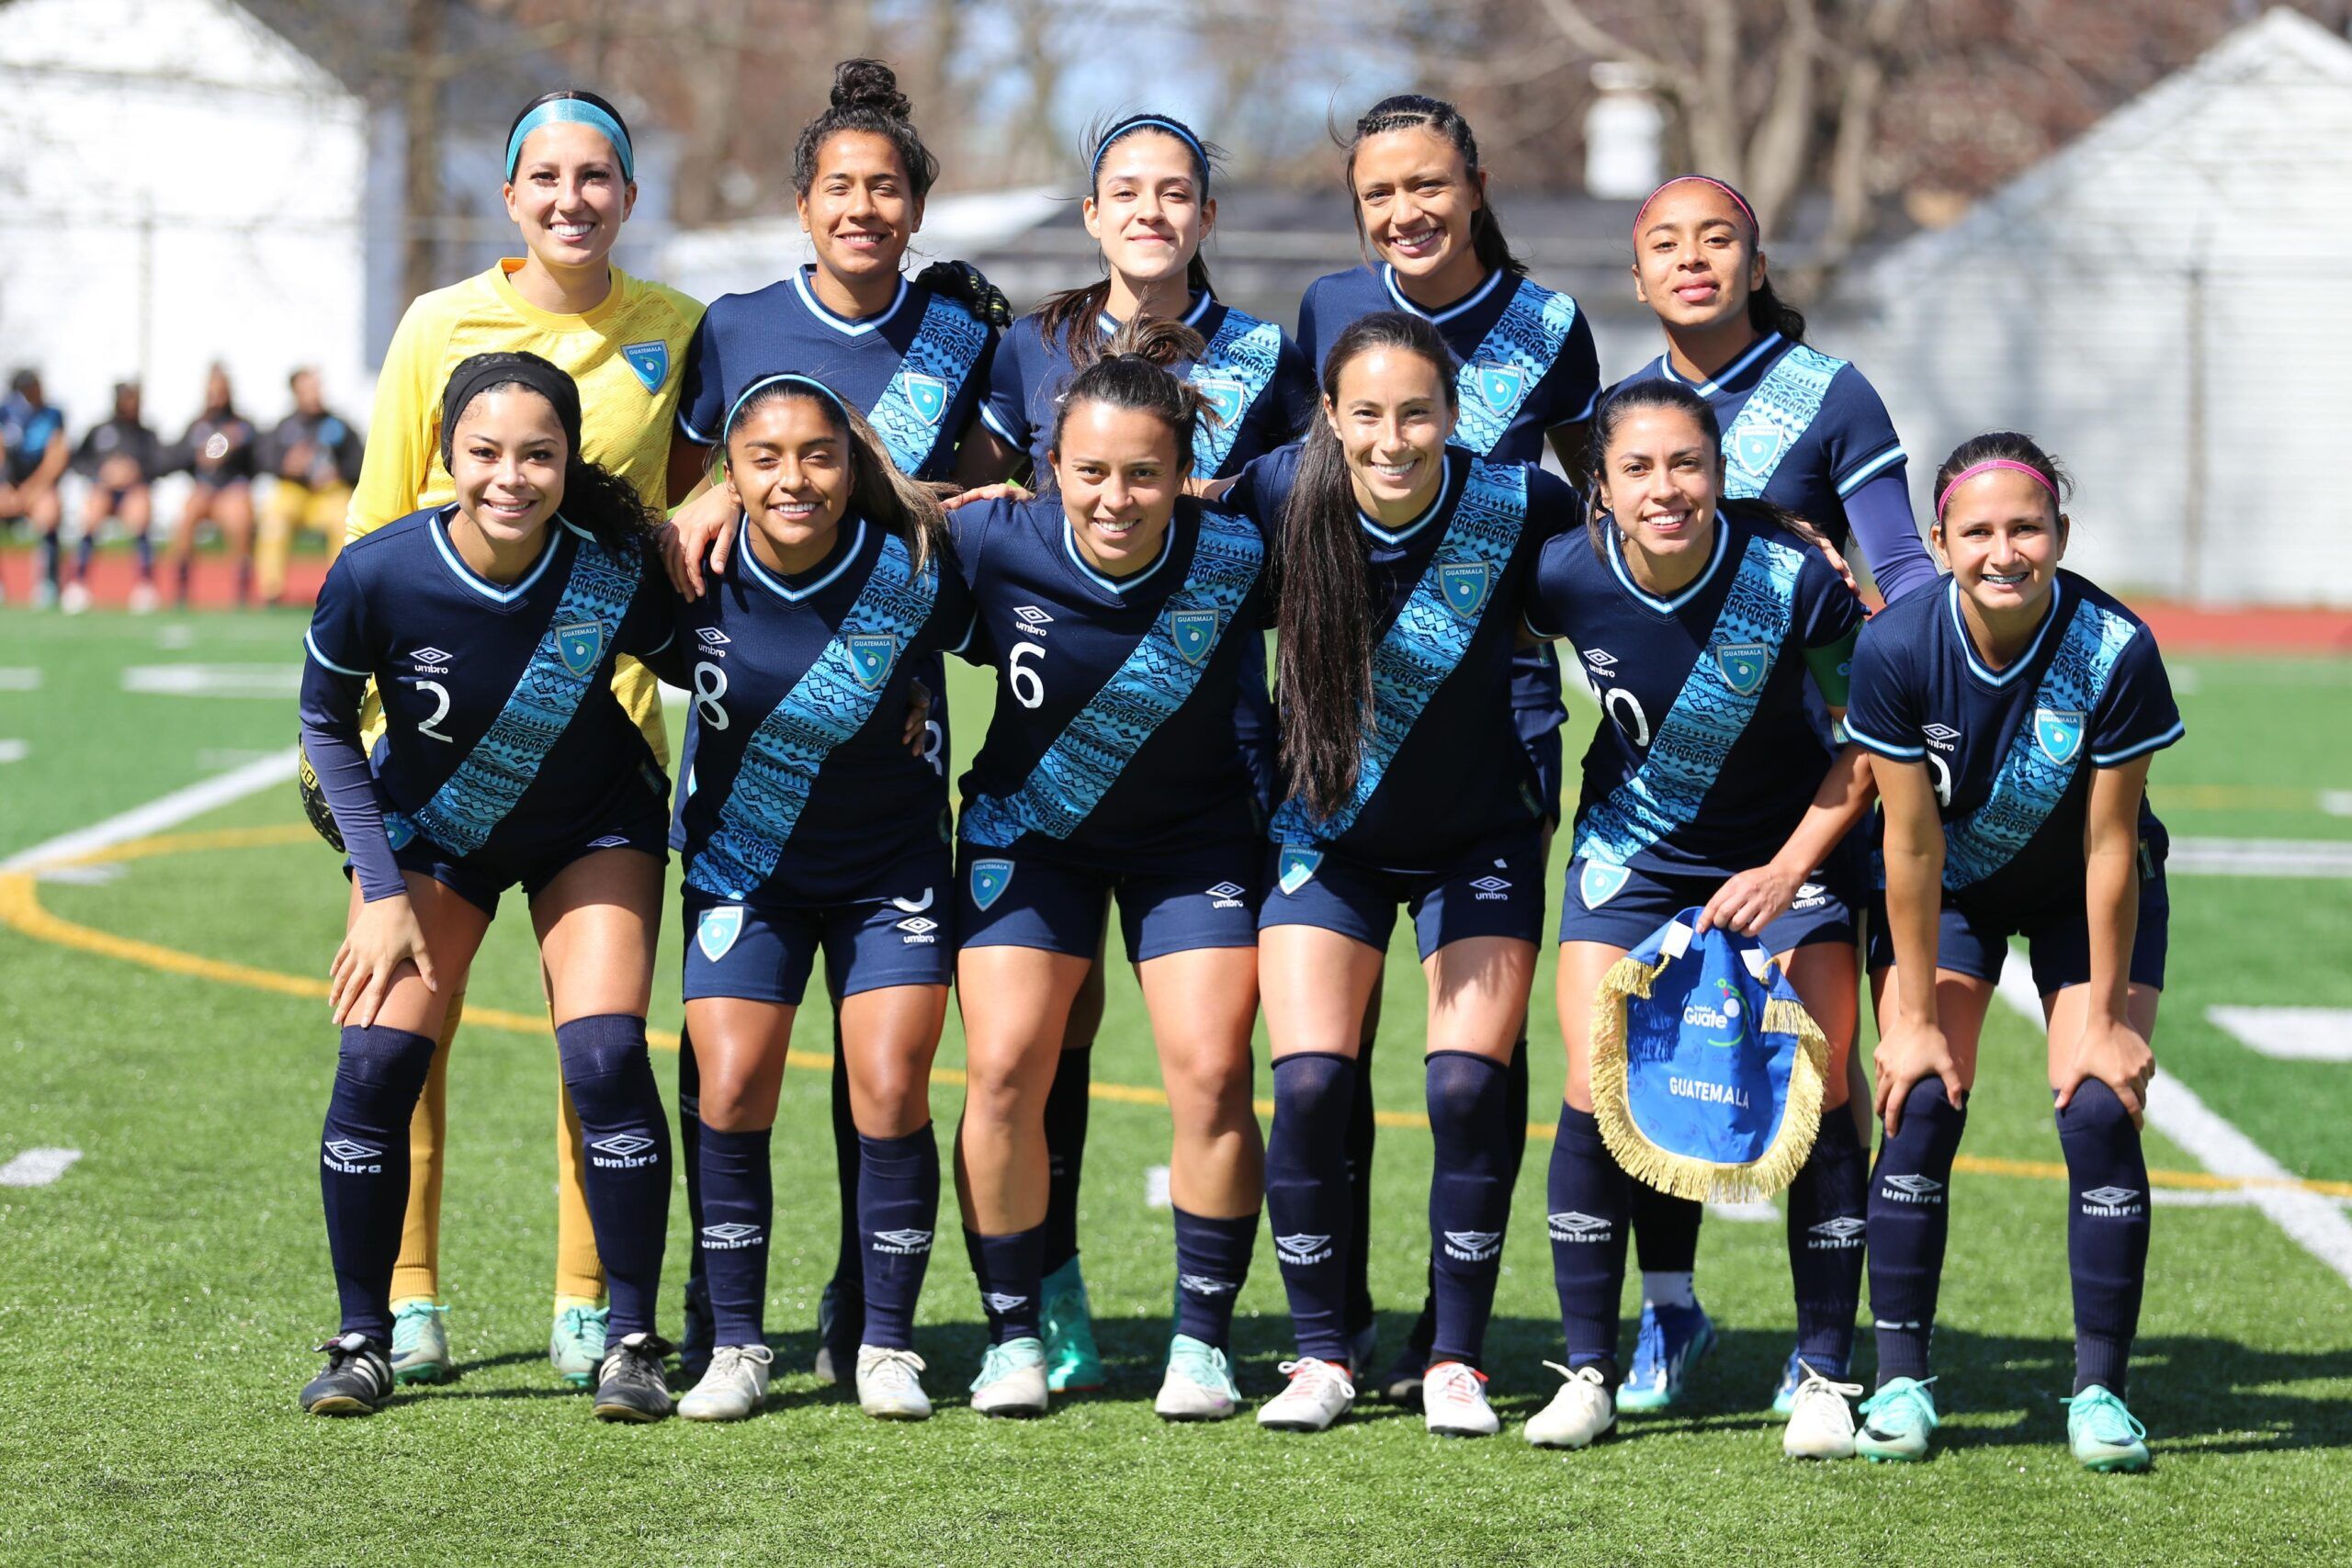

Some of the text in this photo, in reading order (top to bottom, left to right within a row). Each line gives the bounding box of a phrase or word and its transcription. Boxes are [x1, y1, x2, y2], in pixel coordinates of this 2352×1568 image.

[628, 346, 662, 355] GUATEMALA
[1445, 568, 1484, 577] GUATEMALA
[561, 627, 597, 637] GUATEMALA
[1015, 620, 1047, 637] umbro
[698, 643, 726, 658] umbro
[1724, 649, 1762, 658] GUATEMALA
[414, 664, 448, 674] umbro
[1010, 641, 1046, 708] 6
[695, 661, 729, 730] 8
[415, 681, 453, 743] 2
[2040, 716, 2078, 724] GUATEMALA
[1927, 738, 1955, 752] mbro
[975, 863, 1009, 872] GUATEMALA
[1213, 897, 1244, 909] umbro
[1476, 891, 1509, 901] umbro
[1792, 895, 1826, 910] umbro
[903, 934, 935, 943] umbro
[1683, 1006, 1728, 1029] Guate
[1669, 1077, 1749, 1110] GUATEMALA
[323, 1155, 382, 1175] umbro
[593, 1153, 659, 1168] umbro
[1882, 1187, 1941, 1204] umbro
[2082, 1203, 2143, 1217] umbro
[1549, 1229, 1611, 1242] umbro
[702, 1236, 763, 1250] umbro
[873, 1243, 932, 1255] umbro
[1277, 1247, 1332, 1266] umbro
[1444, 1243, 1499, 1262] umbro
